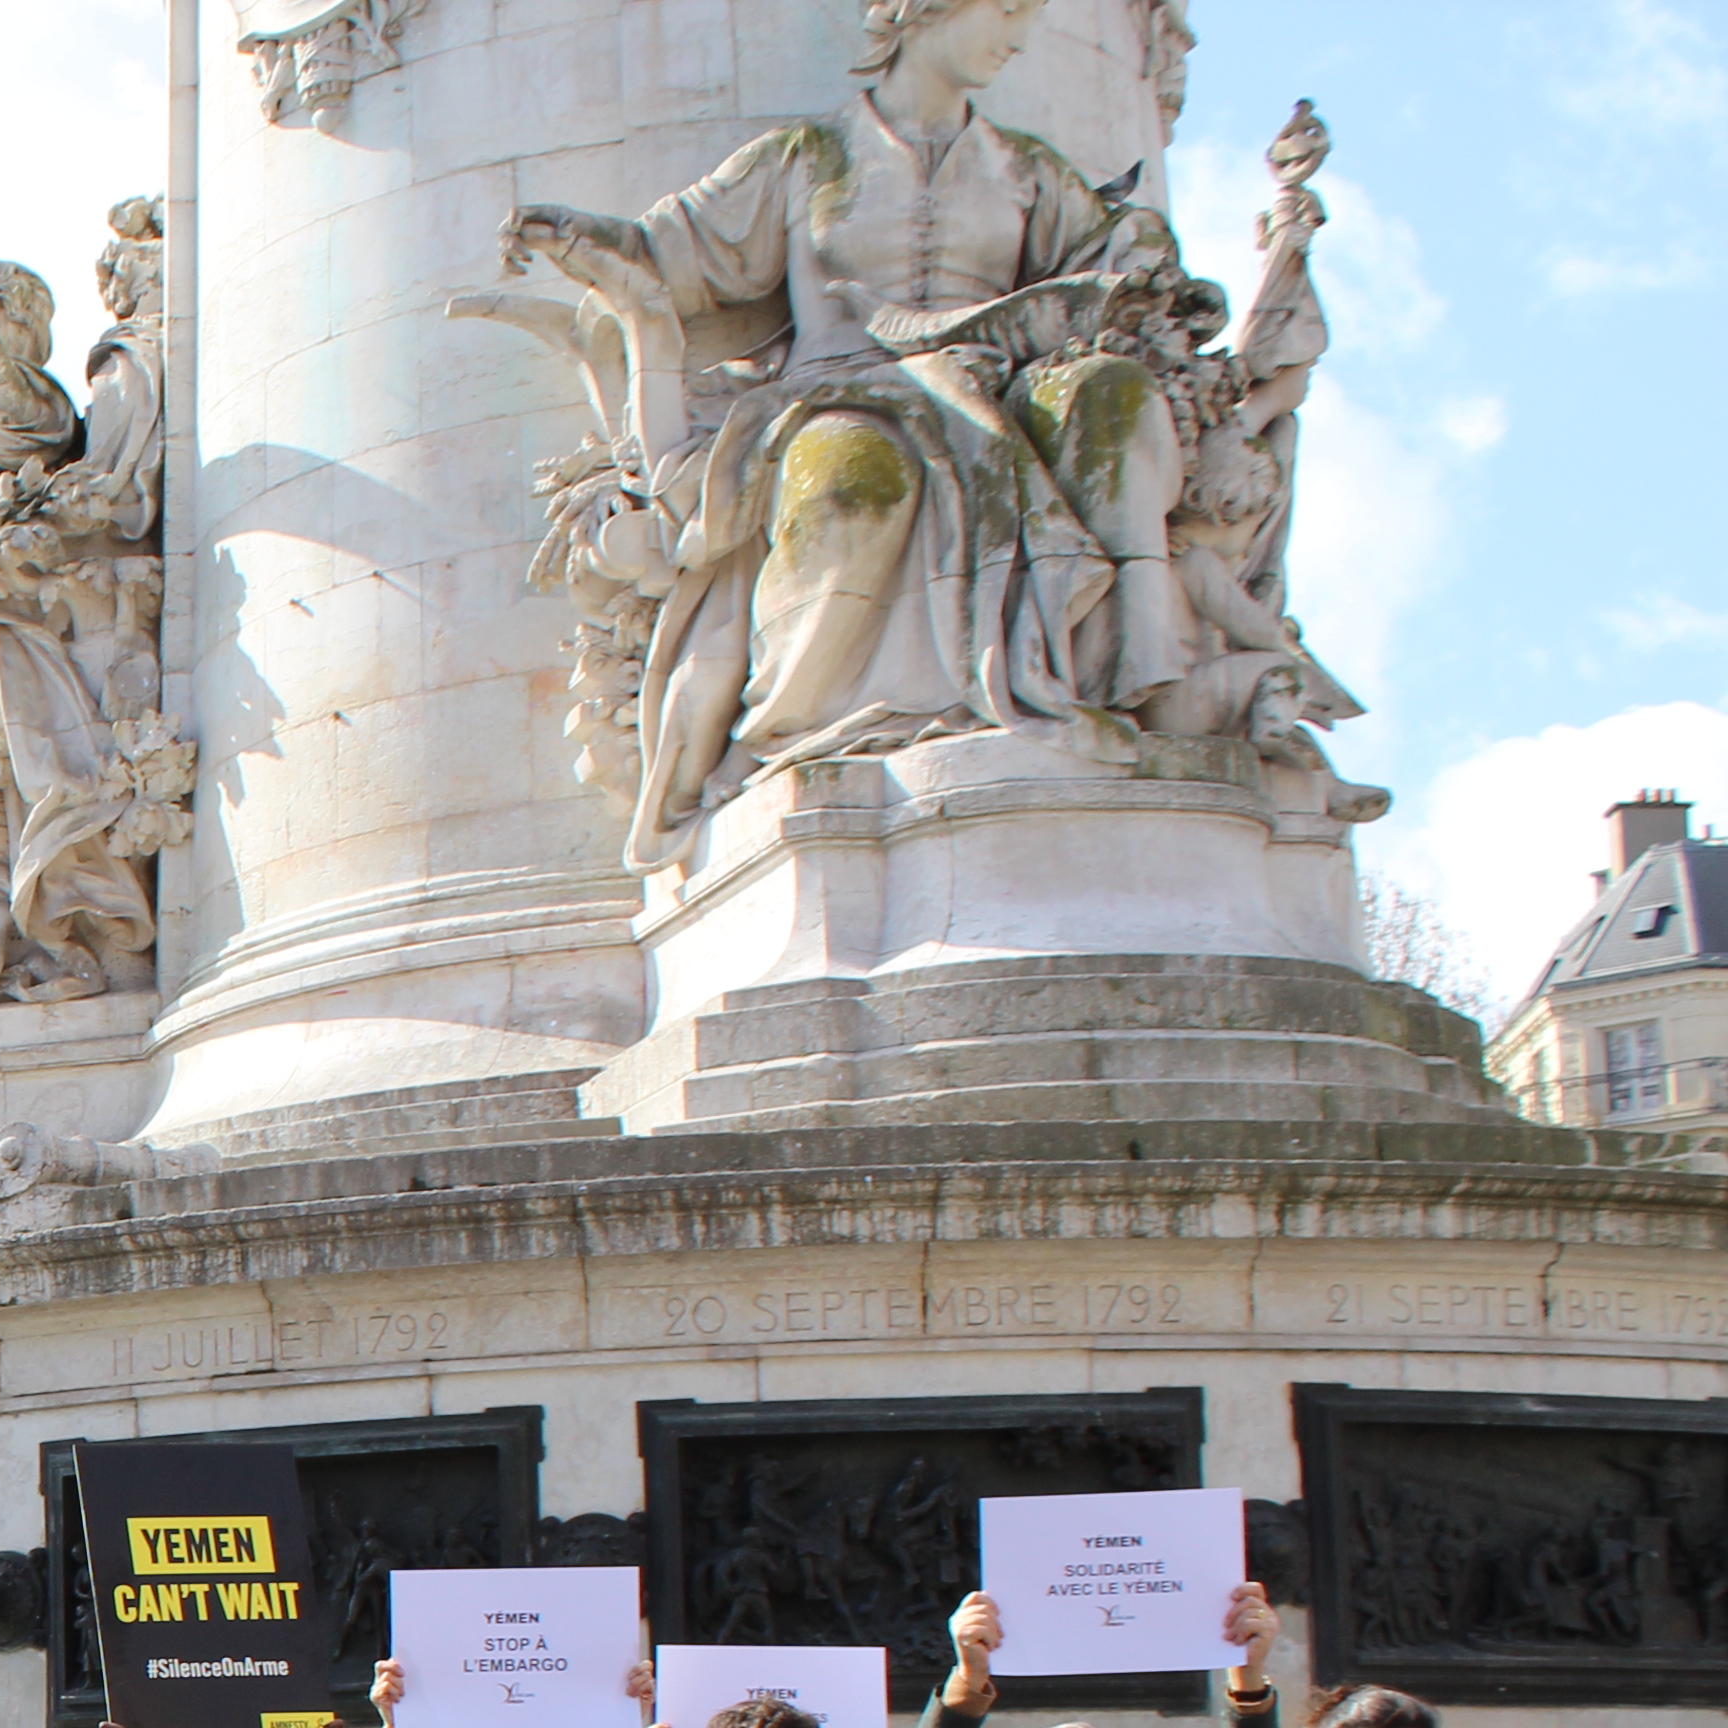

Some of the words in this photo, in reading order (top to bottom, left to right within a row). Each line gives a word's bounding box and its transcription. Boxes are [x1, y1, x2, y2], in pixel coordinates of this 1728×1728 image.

[664, 1297, 727, 1336] 20
[752, 1285, 1057, 1333] SEPTEMBRE
[1083, 1283, 1182, 1323] 1792
[1326, 1284, 1364, 1323] 21
[1389, 1283, 1638, 1331] SEPTEMBRE
[152, 1319, 332, 1371] JUILLET
[353, 1312, 448, 1355] 1792
[140, 1527, 256, 1564] YEMEN
[1084, 1534, 1142, 1548] YÉMEN
[1064, 1560, 1165, 1577] SOLIDARITÉ
[1047, 1582, 1092, 1596] AVEC
[1098, 1581, 1119, 1595] LE
[1124, 1580, 1183, 1594] YÉMEN
[113, 1583, 210, 1623] CAN'T
[215, 1582, 299, 1620] WAIT
[484, 1611, 539, 1624] YÉMEN
[484, 1637, 530, 1651] STOP
[535, 1634, 548, 1650] À
[146, 1656, 289, 1678] #SilenceOnArme
[463, 1657, 568, 1672] L'EMBARGO
